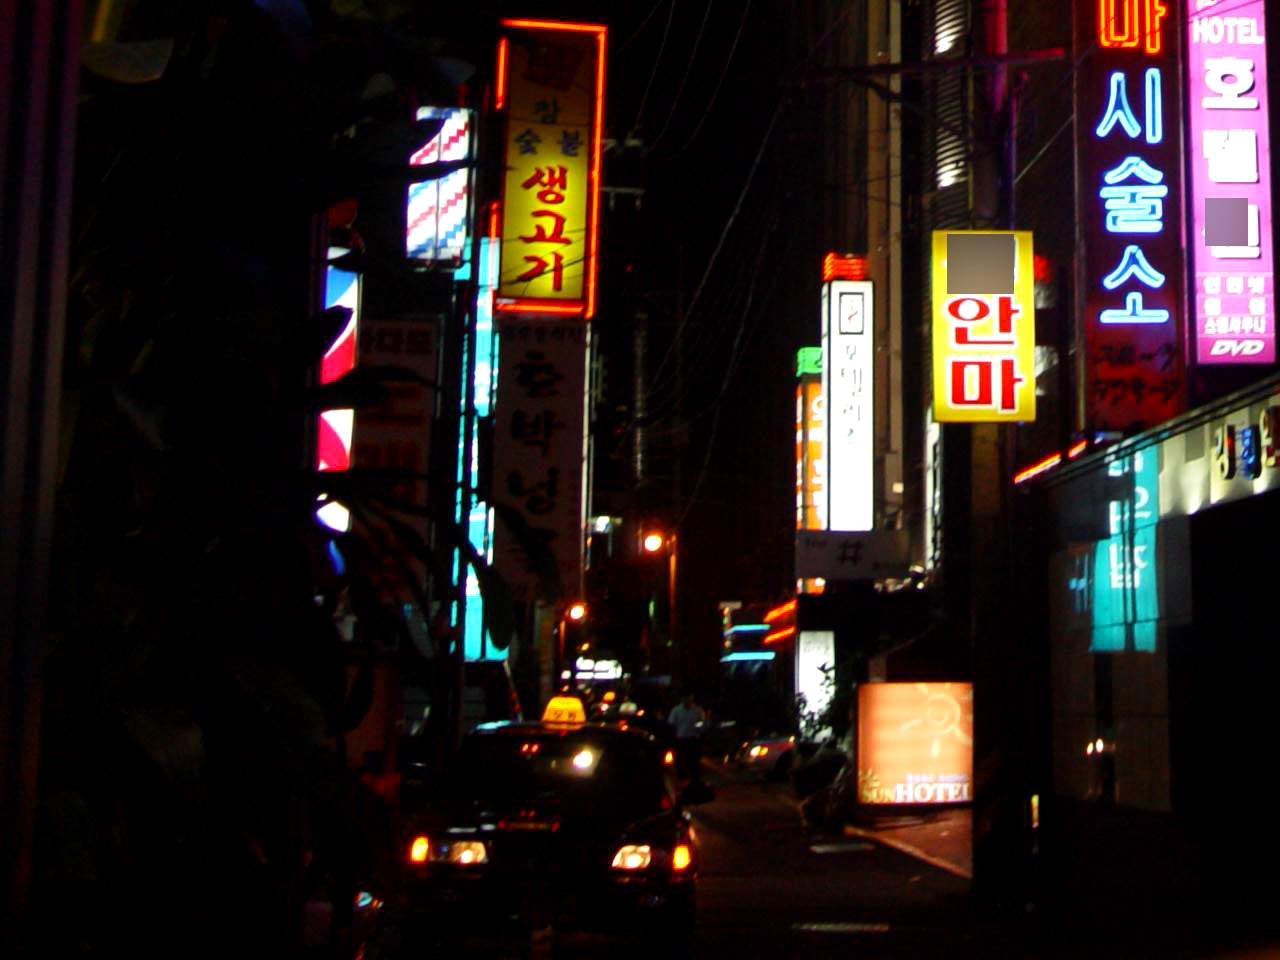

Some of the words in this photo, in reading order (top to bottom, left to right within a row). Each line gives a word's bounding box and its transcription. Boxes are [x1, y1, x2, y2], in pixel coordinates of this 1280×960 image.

[1192, 16, 1265, 45] HOTEL
[517, 165, 572, 292] 생고기
[947, 296, 1023, 411] 안마
[1210, 339, 1265, 356] DVD
[895, 782, 970, 803] HOTEL
